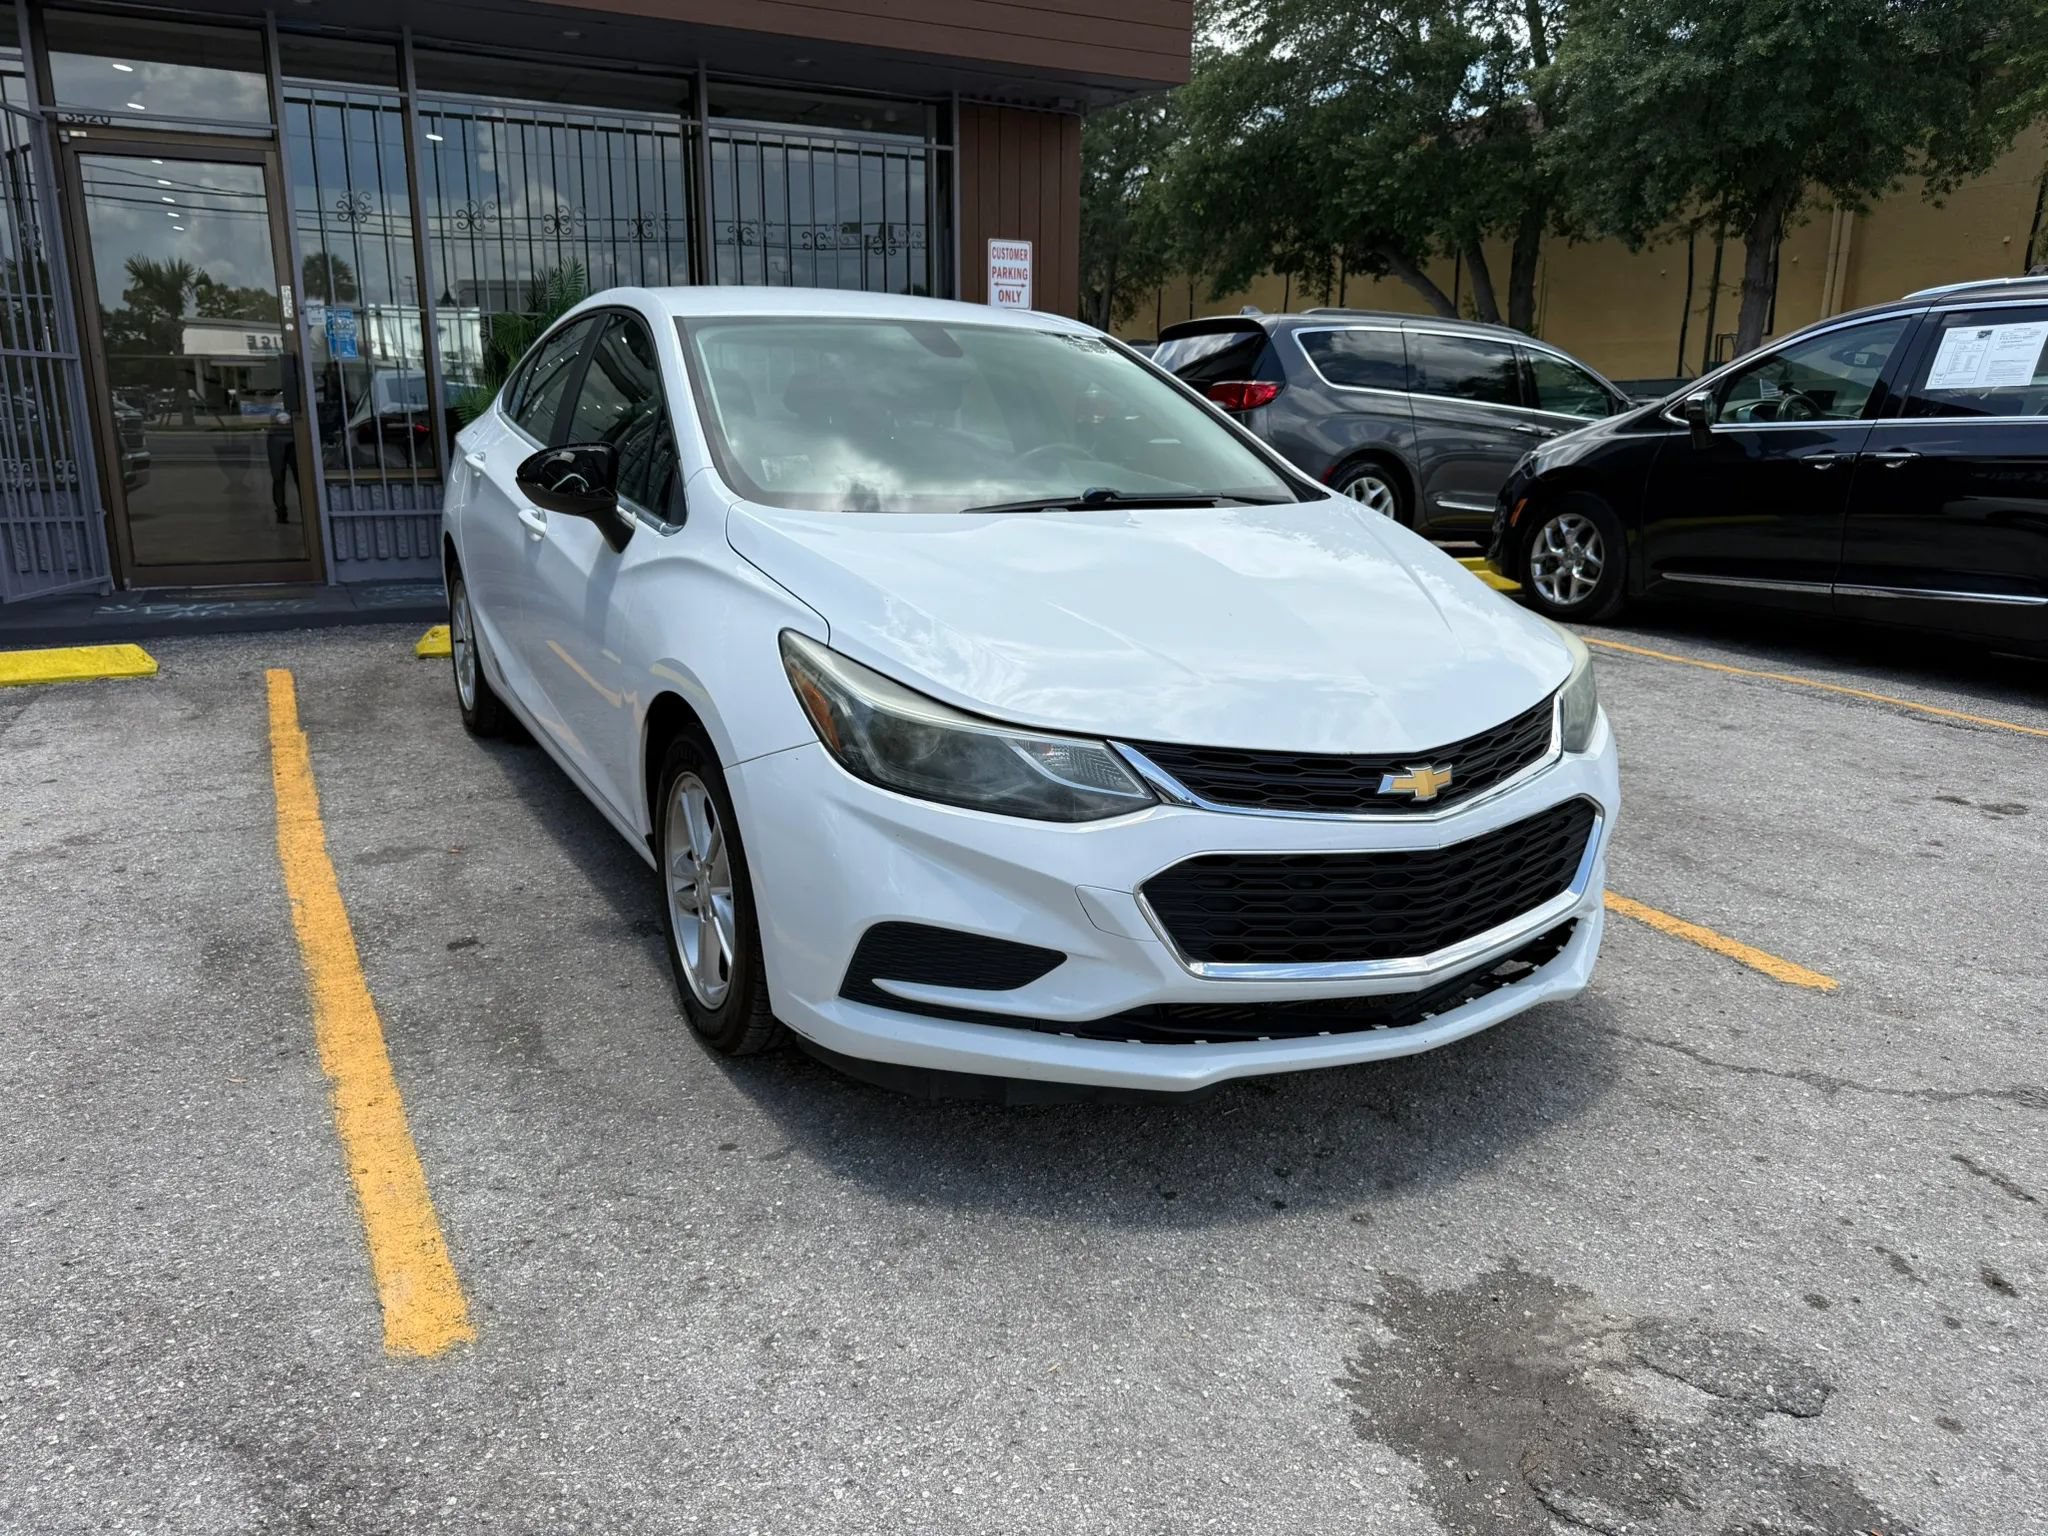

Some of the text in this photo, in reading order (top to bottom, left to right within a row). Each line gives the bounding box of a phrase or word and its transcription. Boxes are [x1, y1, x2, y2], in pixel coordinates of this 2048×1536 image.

[992, 247, 1028, 261] CUSTOMER
[992, 266, 1028, 280] PARKING
[998, 290, 1022, 303] ONLY
